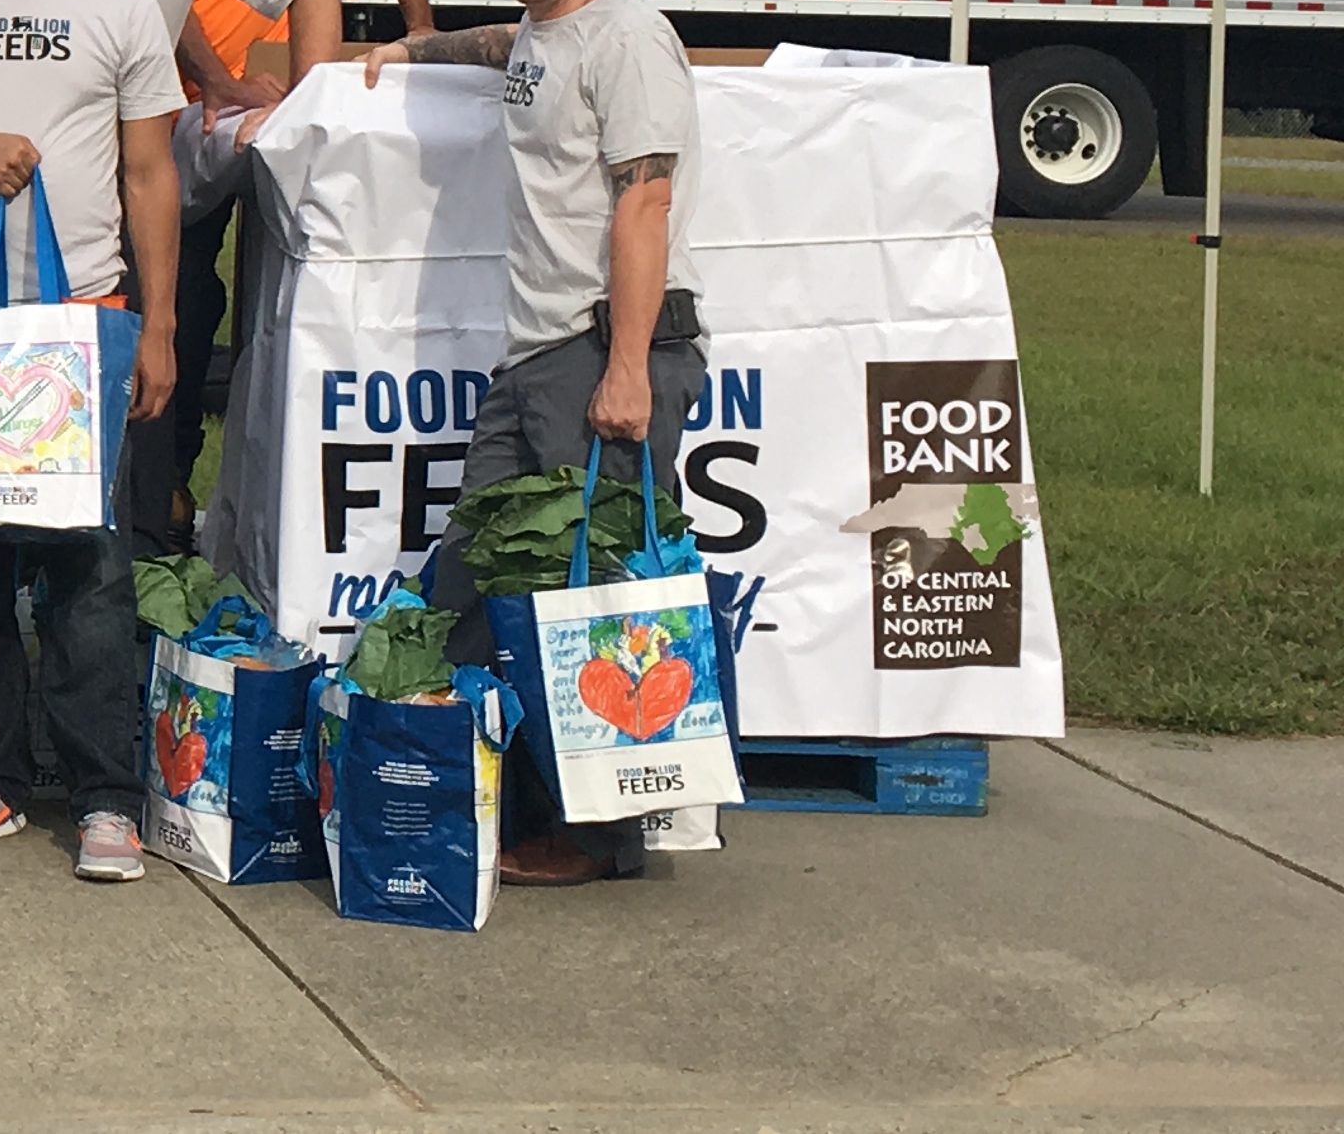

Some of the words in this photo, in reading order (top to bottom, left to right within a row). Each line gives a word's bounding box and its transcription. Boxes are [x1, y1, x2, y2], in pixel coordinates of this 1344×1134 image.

[34, 18, 71, 34] LION
[503, 74, 540, 107] EEDS
[321, 369, 490, 433] FOOD
[682, 368, 763, 431] ON
[881, 400, 1013, 436] FOOD
[882, 438, 1012, 474] BANK
[322, 440, 768, 554] FES
[882, 571, 915, 590] OF
[917, 570, 1011, 590] CENTRAL
[882, 594, 898, 613] &
[902, 594, 995, 613] EASTERN
[883, 617, 964, 636] NORTH
[883, 638, 993, 659] CAROLINA
[616, 766, 643, 778] FOOD
[658, 763, 683, 775] LION
[617, 774, 685, 796] FEEDS
[158, 826, 192, 853] FEEDS
